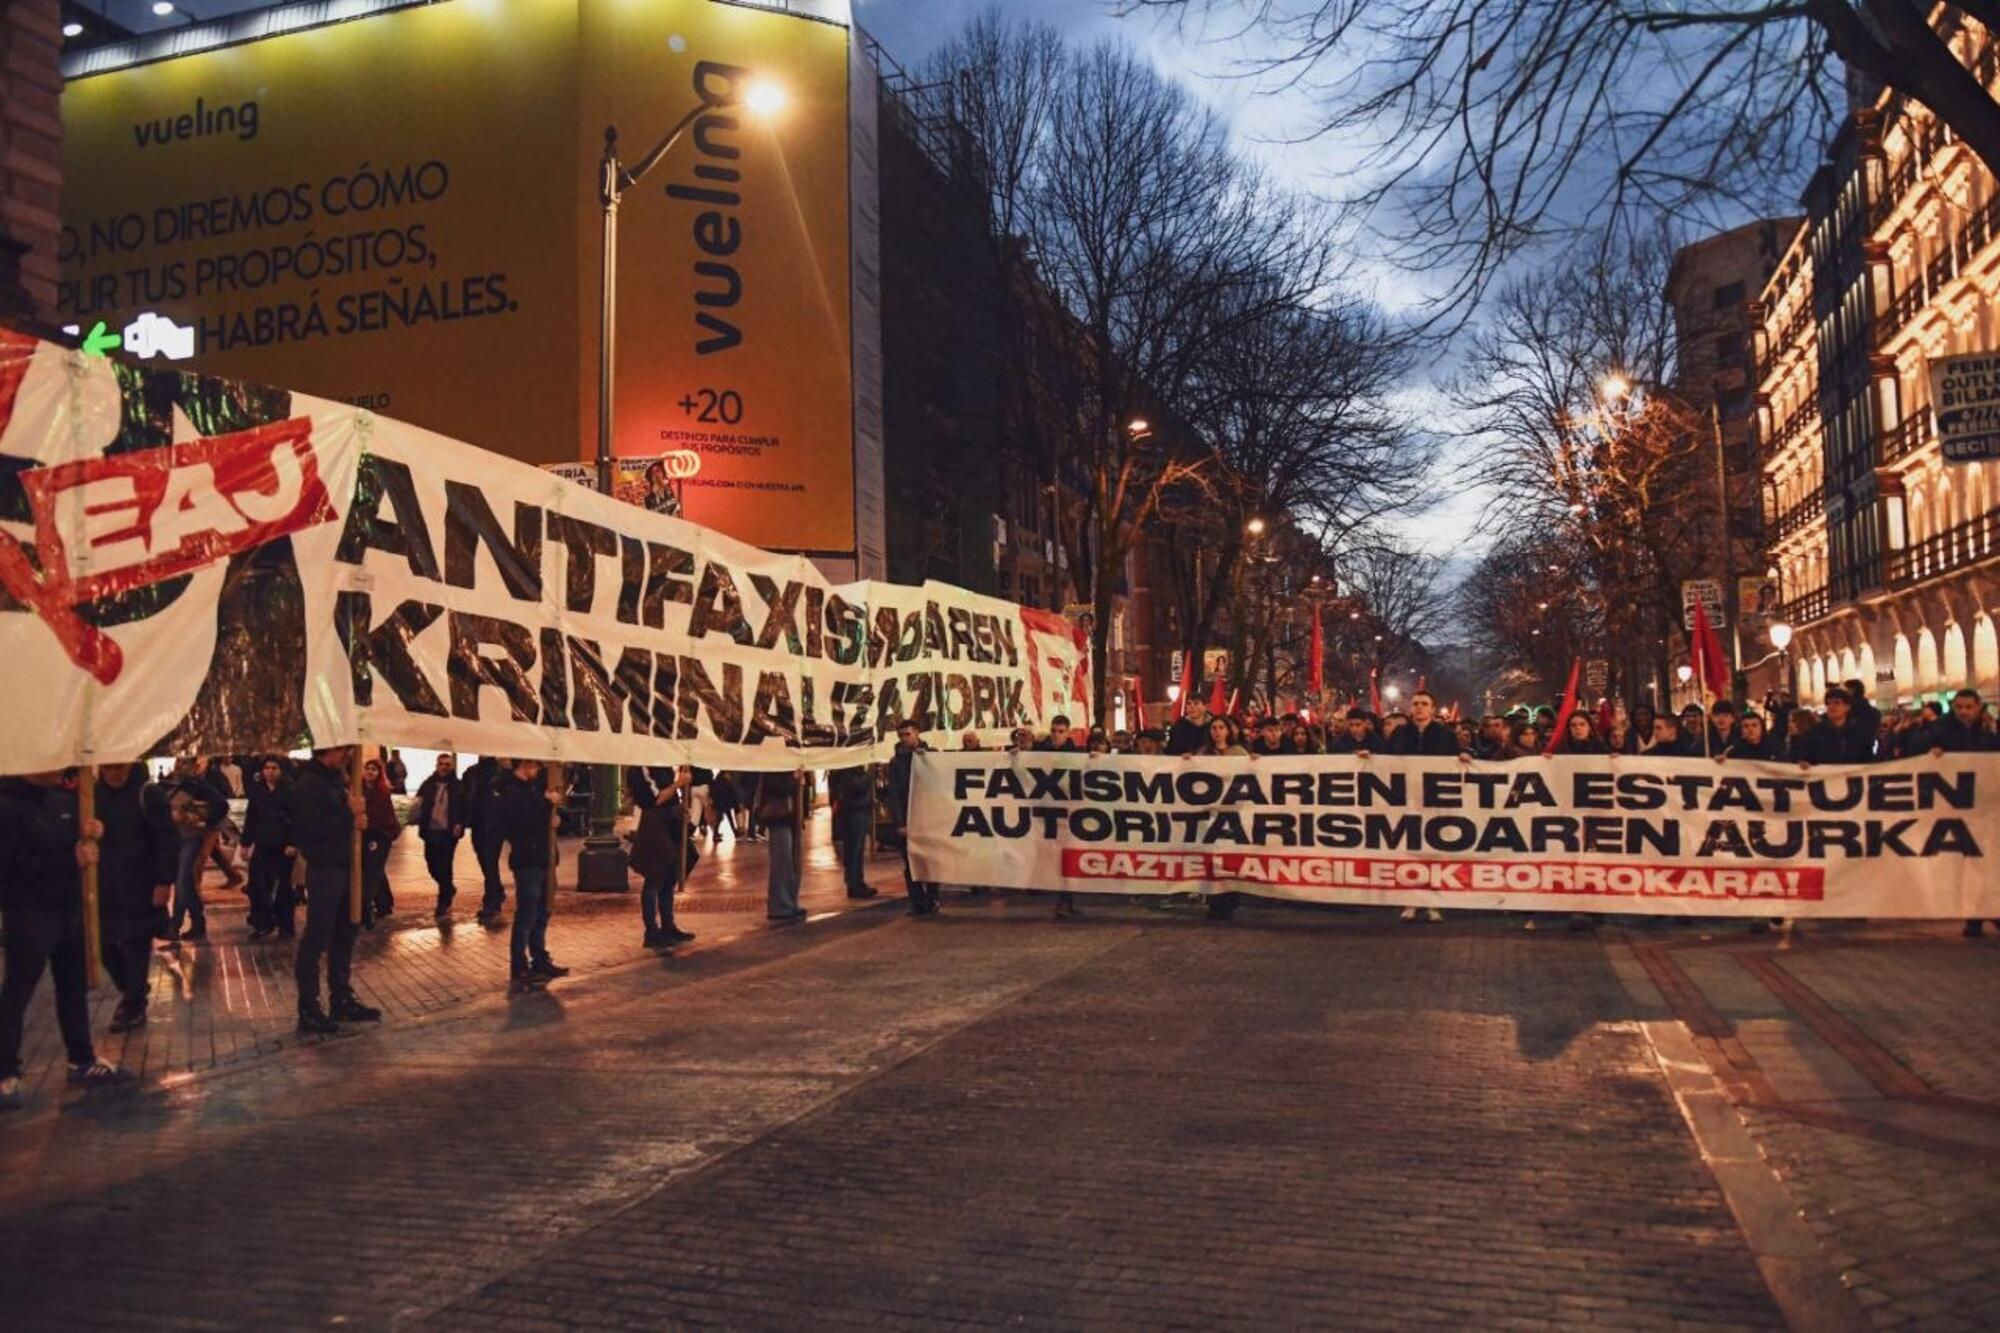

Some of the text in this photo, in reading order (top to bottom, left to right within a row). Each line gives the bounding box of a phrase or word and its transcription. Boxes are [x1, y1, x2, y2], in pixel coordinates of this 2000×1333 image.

[134, 98, 259, 147] vueling
[92, 214, 145, 256] NO
[154, 183, 311, 246] DIREMOS
[321, 161, 449, 214] CÓMO
[665, 60, 752, 356] vueling
[126, 263, 186, 305] TUS
[195, 224, 437, 296] PROPÓSITOS,
[201, 273, 518, 353] HABRÁ SEÑALES.
[661, 431, 709, 442] DESTINOS
[711, 433, 736, 444] PARA
[678, 388, 743, 424] +20
[55, 439, 304, 579] EAJ
[335, 452, 1018, 668] ANTIFAXISMOAREN
[334, 590, 1032, 748] KRIMINALIZAZIORIK
[954, 768, 1976, 812] FAXISMOAREN ETA ESTATUEN
[951, 806, 1983, 859] AUTORITARISMOAREN AURKA
[1079, 850, 1206, 879] GAZTE
[1471, 863, 1800, 896] BORROKARA!
